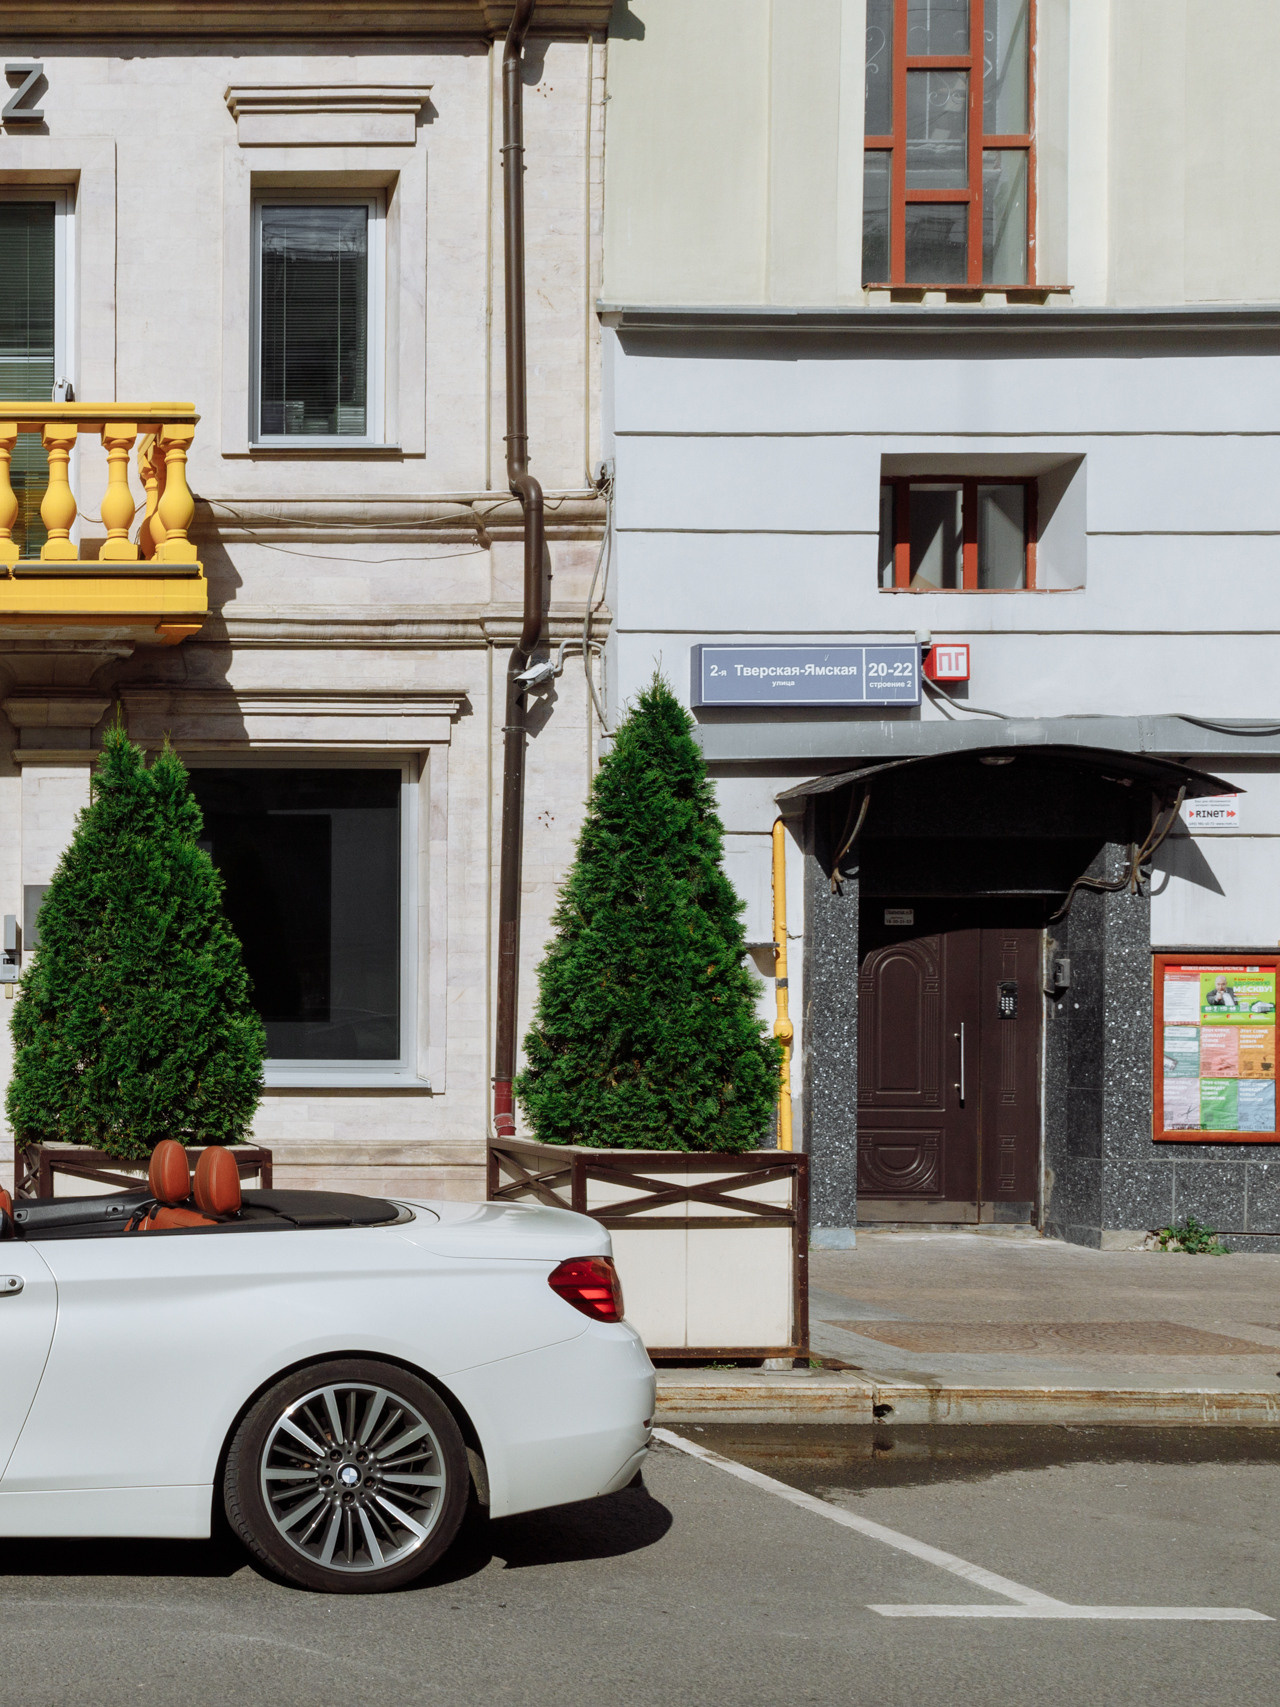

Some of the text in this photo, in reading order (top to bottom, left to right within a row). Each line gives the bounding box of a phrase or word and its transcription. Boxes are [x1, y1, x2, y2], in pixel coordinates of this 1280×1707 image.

[938, 652, 965, 671] ПГ
[710, 663, 857, 678] 2-я Тверская-Ямская
[868, 662, 913, 677] 20-22
[772, 680, 796, 688] улица
[869, 680, 912, 689] строение 2
